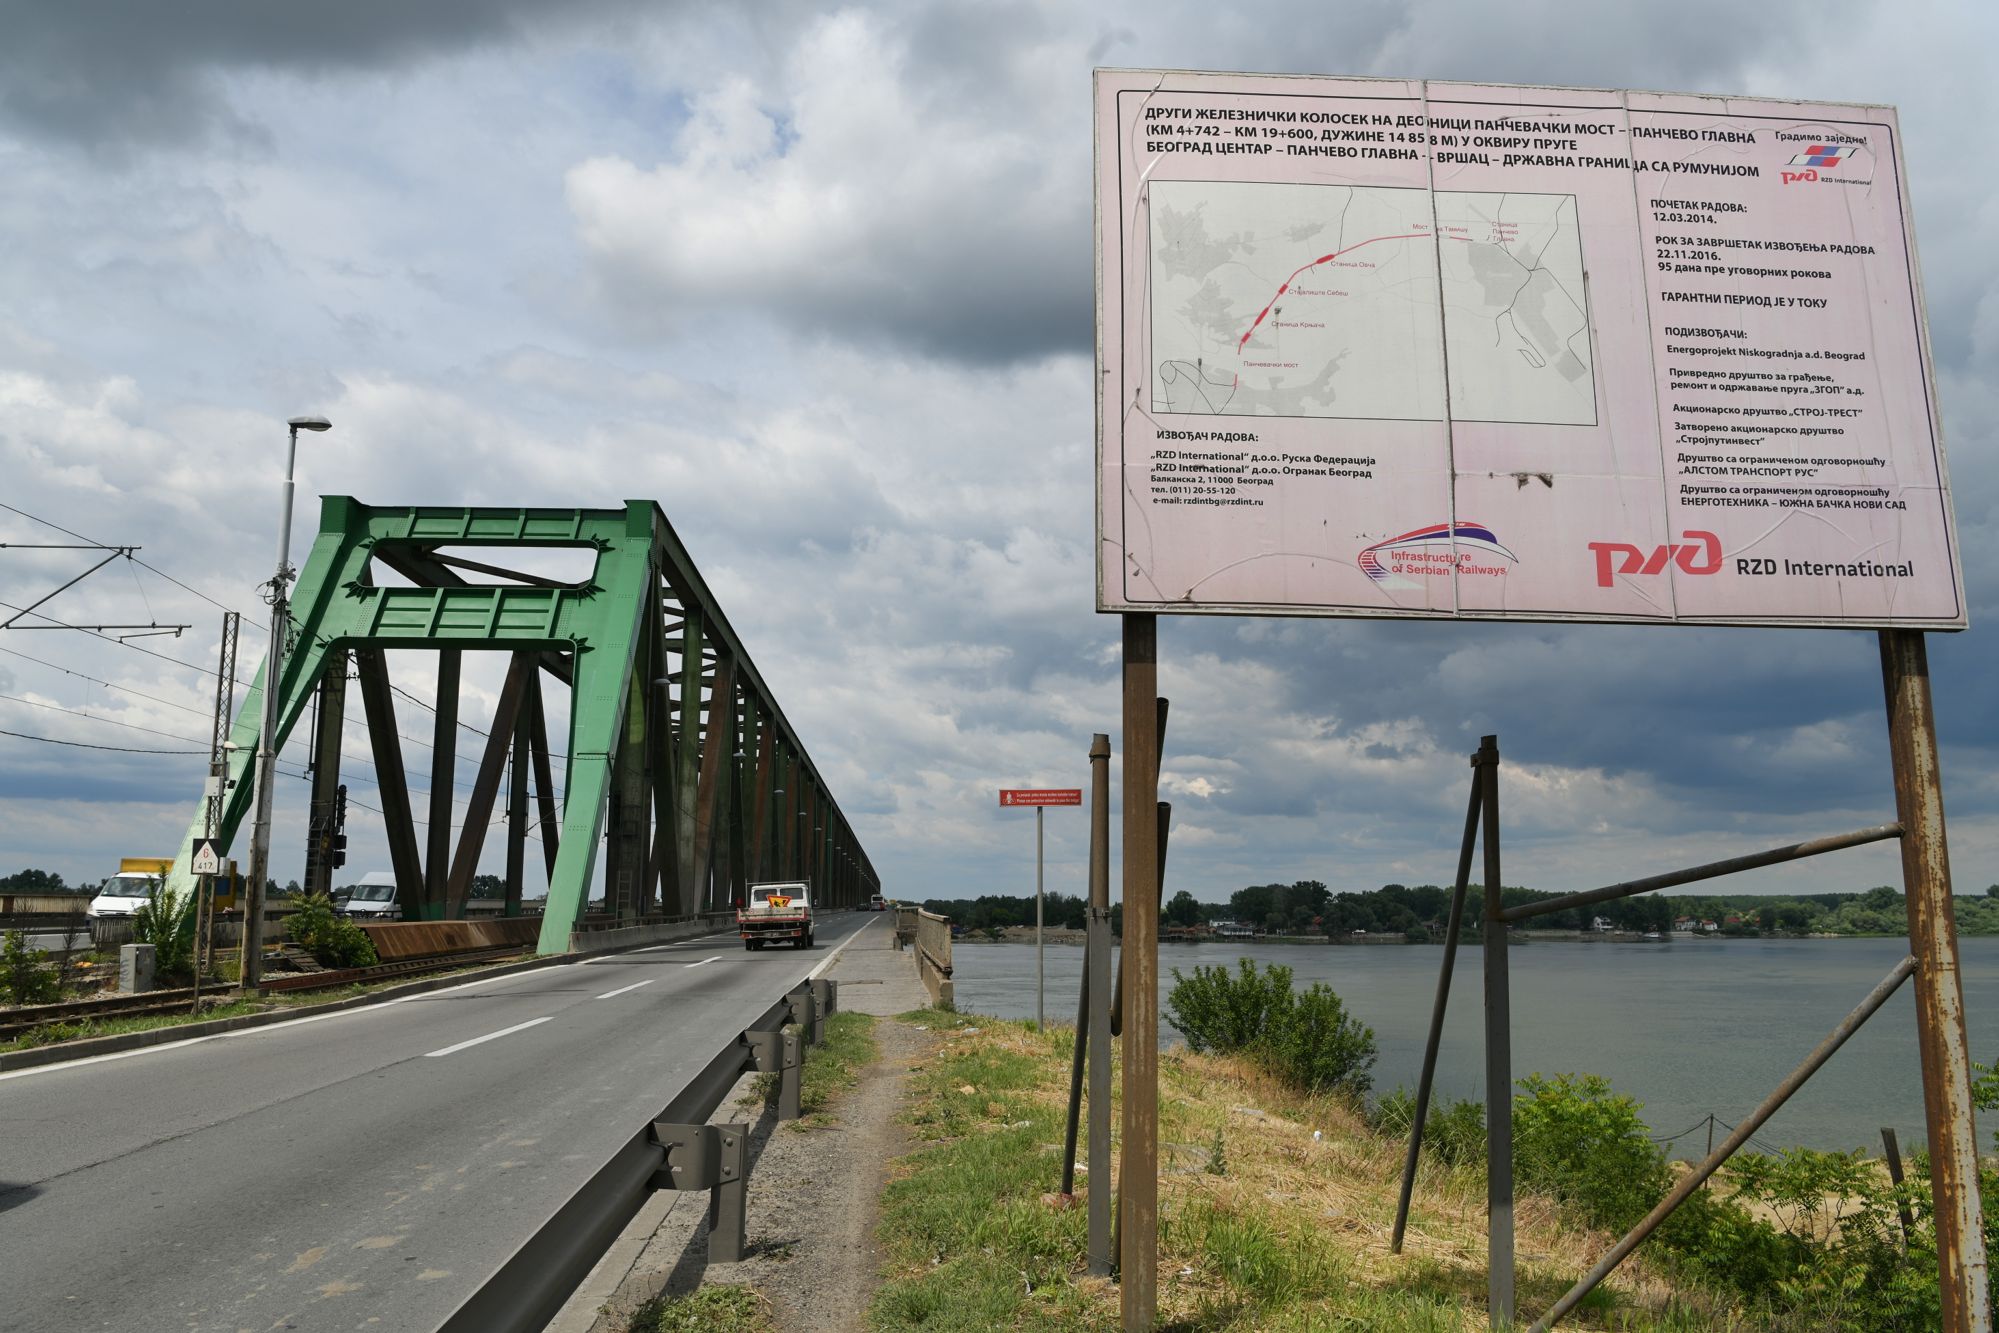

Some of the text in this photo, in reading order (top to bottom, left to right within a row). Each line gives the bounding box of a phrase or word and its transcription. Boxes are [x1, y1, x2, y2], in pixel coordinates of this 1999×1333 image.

[1145, 108, 1192, 120] ДРУГИ
[1196, 109, 1296, 122] ЖЕЛЕЗНИЧКИ
[1300, 113, 1368, 125] КОЛОСЕК
[1372, 115, 1392, 125] НА
[1396, 116, 1471, 131] ДЕОНИЦИ
[1475, 120, 1571, 133] ПАНЧЕВАЧКИ
[1575, 124, 1615, 135] МОСТ
[1633, 127, 1698, 140] ПАНЧЕВО
[1702, 131, 1756, 144] ГЛАВНА
[1146, 125, 1173, 136] (КМ
[1177, 126, 1220, 137] 4+742
[1235, 127, 1257, 137] КМ
[1262, 128, 1317, 141] 19+600,
[1321, 130, 1384, 142] ДУЖИНЕ
[1389, 133, 1405, 143] 14
[1442, 135, 1458, 147] М)
[1462, 136, 1470, 146] У
[1474, 136, 1530, 149] ОКВИРУ
[1534, 138, 1577, 150] ПРУГЕ
[1776, 132, 1867, 145] Градимо заједно!
[1147, 142, 1213, 155] БЕОГРАД
[1216, 143, 1272, 155] ЦЕНТАР
[1288, 145, 1357, 157] ПАНЧЕВО
[1362, 148, 1418, 160] ГЛАВНА
[1438, 152, 1489, 166] ВРШАЦ
[1503, 154, 1575, 167] ДРЖАВНА
[1579, 157, 1648, 172] ГРАНИЦА
[1652, 161, 1670, 172] СА
[1673, 162, 1759, 177] РУМУНИЈОМ
[1835, 178, 1872, 186] International
[1650, 200, 1747, 213] ПОЧЕТАК РАДОВА:
[1653, 213, 1717, 224] 12.03.2014.
[1656, 236, 1875, 255] РОК ЗА ЗАВРШЕТАК ИЗВОЂЕЊА РАДОВА
[1657, 250, 1721, 261] 22.11.2016.
[1658, 262, 1832, 279] 95 дана пре уговорних рокова
[1662, 292, 1827, 308] ГАРАНТНИ ПЕРИОД ЈЕ У ТОКУ
[1665, 327, 1748, 339] ПОДИЗВОЂАЧИ:
[1667, 345, 1865, 361] Energoprojekt Niskogradnja a.d. Beograd
[1670, 368, 1726, 378] Привредно
[1729, 372, 1773, 382] друштво
[1788, 373, 1834, 383] грађење,
[1671, 382, 1707, 391] ремонт
[1719, 385, 1778, 393] одржавање
[1780, 386, 1809, 395] пруга
[1846, 388, 1864, 396] а.д.
[1673, 404, 1740, 415] Акционарско
[1743, 407, 1787, 417] друштво
[1675, 422, 1844, 436] Затворено акционарско друштво
[1156, 430, 1259, 442] ИЗВОЂАЧ РАДОВА:
[1150, 451, 1176, 459] „RZD
[1251, 454, 1280, 462] д.о.о.
[1282, 454, 1311, 464] Руска
[1314, 454, 1376, 465] Федерација
[1678, 454, 1724, 464] Друштво
[1740, 457, 1808, 465] ограниченом
[1811, 458, 1885, 467] одговорношћу
[1150, 464, 1176, 473] „RZD
[1252, 467, 1280, 475] д.о.о.
[1283, 466, 1326, 477] Огранак
[1329, 468, 1372, 479] Београд
[1679, 466, 1728, 476] „АЛСТОМ
[1730, 468, 1792, 477] ТРАНСПОРТ
[1151, 475, 1196, 484] Балканска
[1198, 477, 1205, 485] 2,
[1237, 477, 1273, 486] Београд
[1170, 486, 1191, 495] (011)
[1193, 487, 1236, 495] 20-55-120
[1680, 485, 1727, 495] Друштво
[1743, 489, 1812, 497] ограниченом
[1815, 488, 1890, 498] одговорношћу
[1184, 497, 1264, 507] rzdintbg@rzdint.ru
[1681, 498, 1769, 507] ЕНЕРГОТЕХНИКА
[1780, 499, 1814, 508] ЮЖНА
[1817, 500, 1851, 509] БАЧКА
[1854, 500, 1882, 509] НОВИ
[1885, 501, 1906, 511] САД
[1392, 551, 1471, 563] Infrastructure
[1392, 564, 1506, 577] of Serbian Railways
[1737, 558, 1914, 577] RZD International
[203, 848, 209, 858] 6
